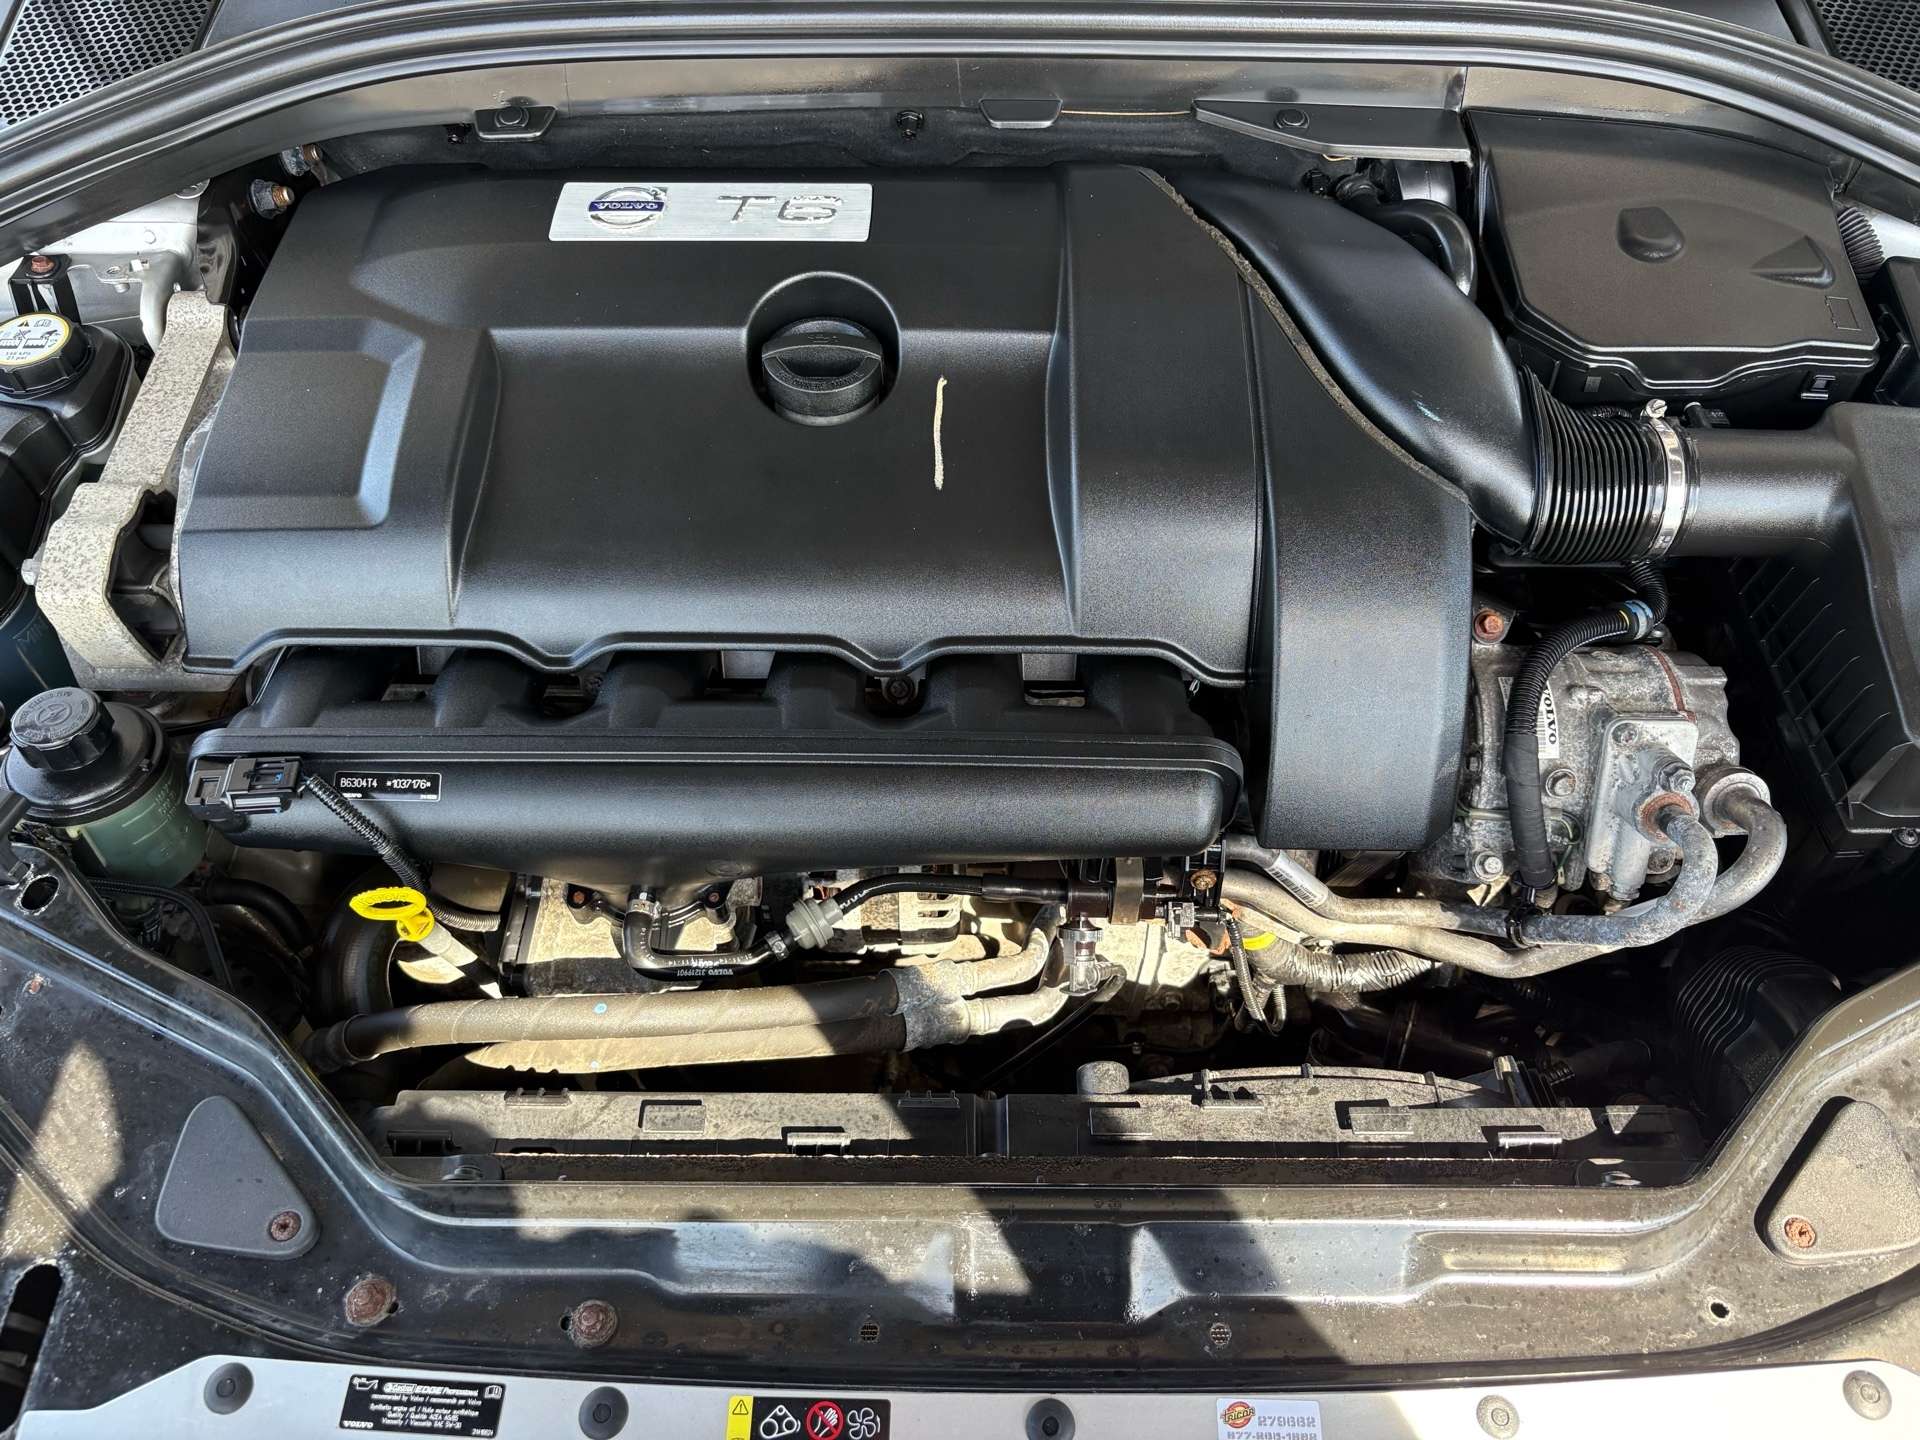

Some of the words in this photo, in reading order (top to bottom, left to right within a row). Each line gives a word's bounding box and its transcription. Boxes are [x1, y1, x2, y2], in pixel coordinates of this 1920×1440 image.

[593, 201, 658, 210] VOLVO
[717, 195, 843, 223] T6
[340, 777, 378, 788] B6304T4
[415, 1385, 444, 1395] EDGE
[342, 1420, 374, 1429] VOLVO
